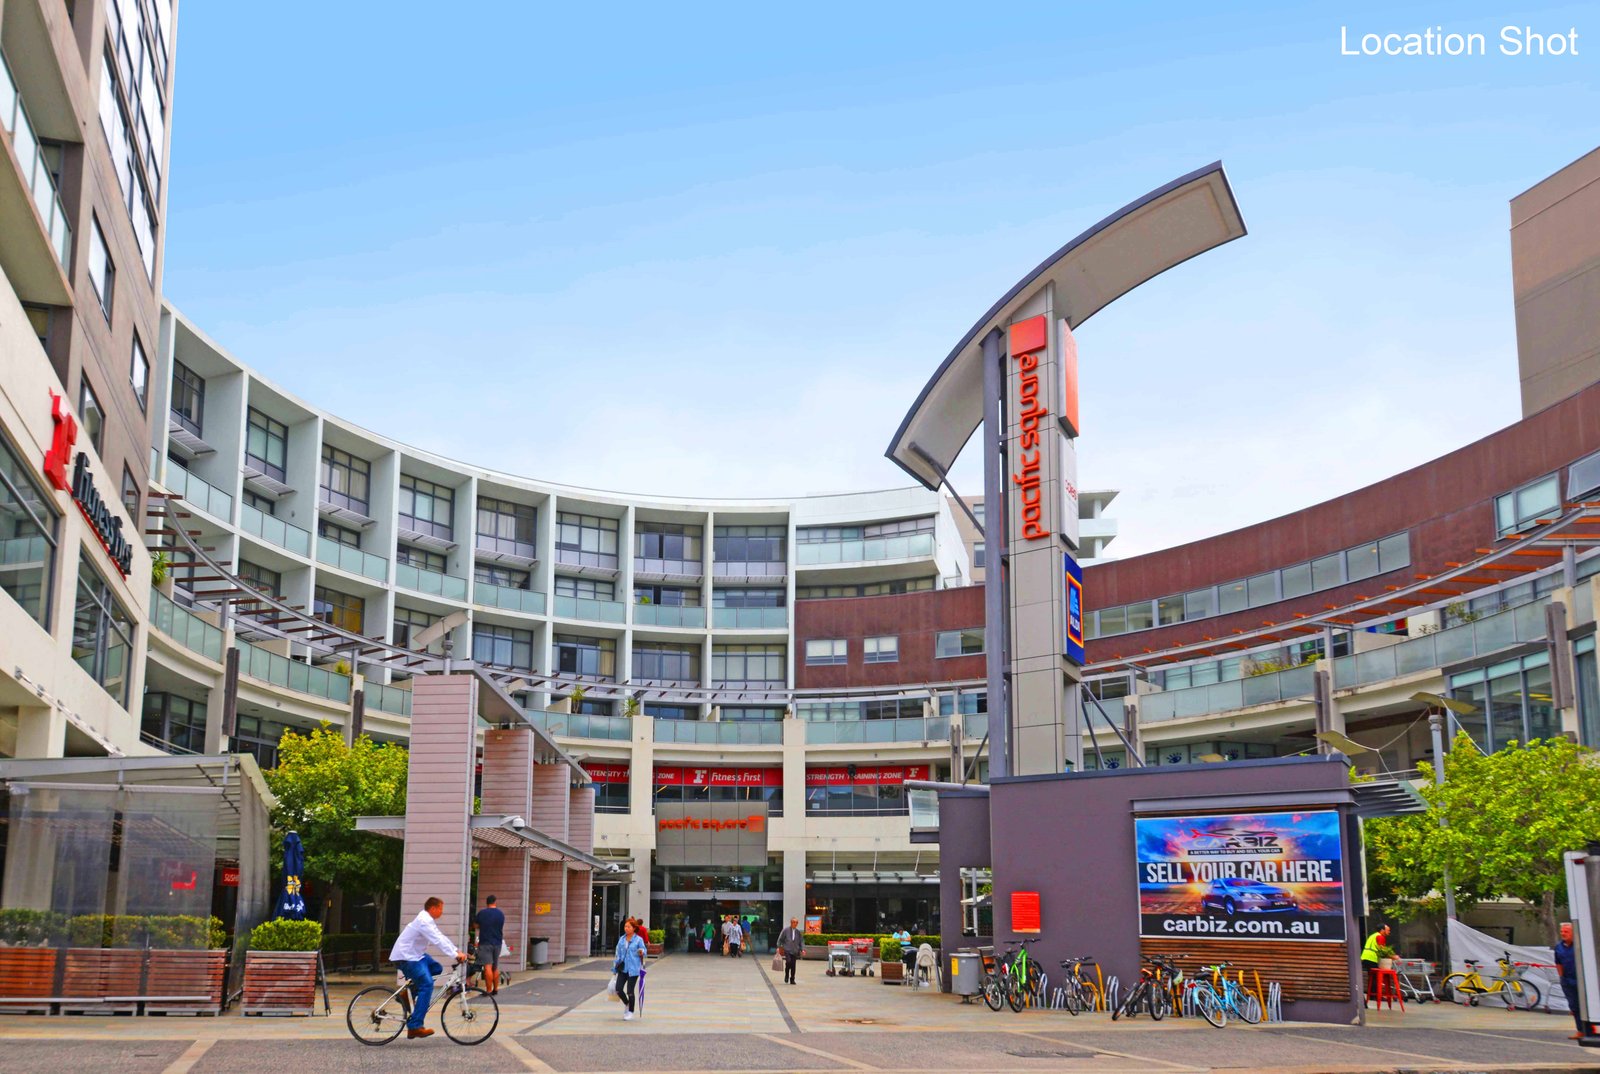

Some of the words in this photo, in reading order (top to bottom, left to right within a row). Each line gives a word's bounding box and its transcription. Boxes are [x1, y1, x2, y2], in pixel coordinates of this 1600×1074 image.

[1018, 353, 1048, 450] square
[1013, 450, 1050, 541] pacific
[72, 451, 117, 546] fitness
[108, 516, 133, 575] first
[657, 772, 675, 780] ZONE
[711, 771, 742, 782] fitness
[742, 772, 761, 782] first
[806, 773, 845, 781] STRENGTH
[846, 772, 881, 780] TAINING
[882, 771, 902, 779] ZONE
[658, 815, 701, 833] pacific
[702, 818, 748, 833] square
[1193, 836, 1279, 848] CARBIZ
[1146, 863, 1187, 883] SELL
[1191, 862, 1236, 882] YOUR
[1240, 861, 1279, 882] CAR
[1281, 860, 1333, 882] HERE
[1163, 916, 1320, 935] carbiz.com.au
